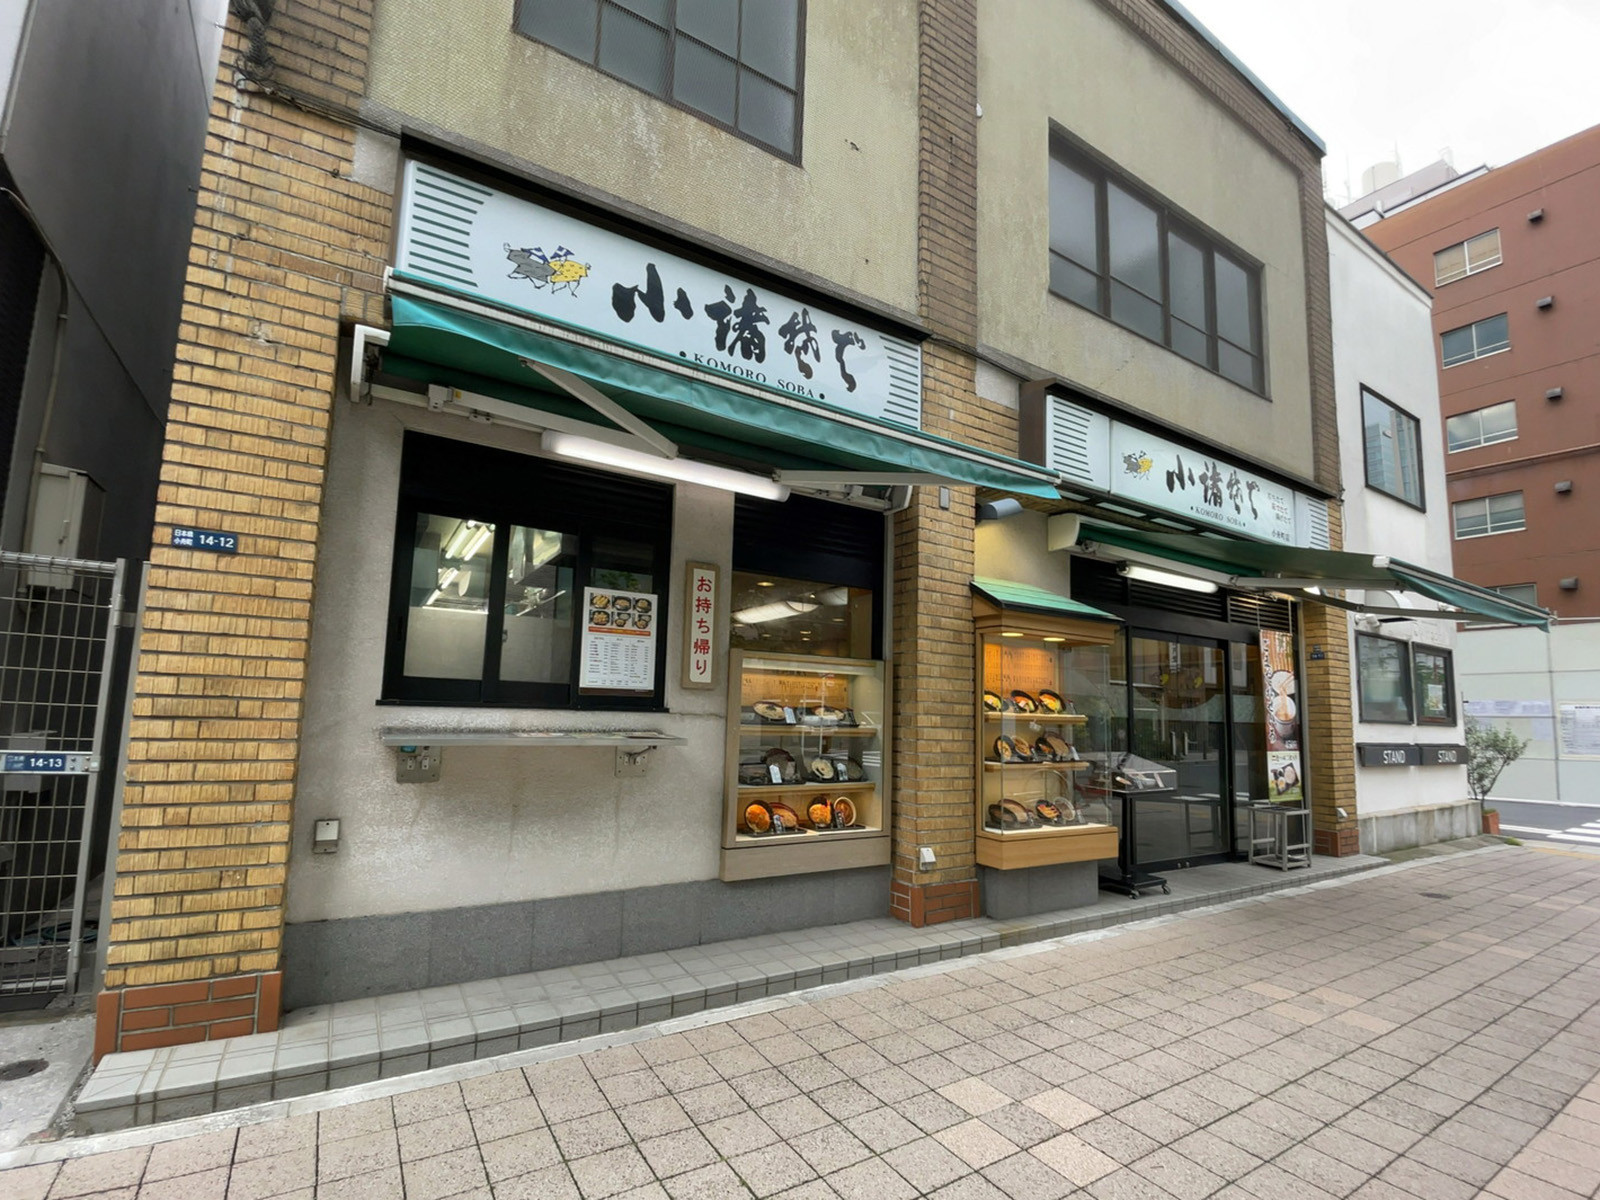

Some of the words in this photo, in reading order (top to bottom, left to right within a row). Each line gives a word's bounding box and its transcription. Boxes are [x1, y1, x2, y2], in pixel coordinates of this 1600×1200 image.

[694, 353, 767, 383] KOMORO
[777, 378, 815, 399] SOBA
[1195, 506, 1223, 521] KOMORO
[1226, 515, 1242, 527] SOBA
[199, 535, 234, 548] 14-12
[694, 576, 712, 675] お持ち帰り
[30, 758, 62, 767] 14-13
[1383, 749, 1406, 764] STAND
[1438, 750, 1457, 763] STAND
